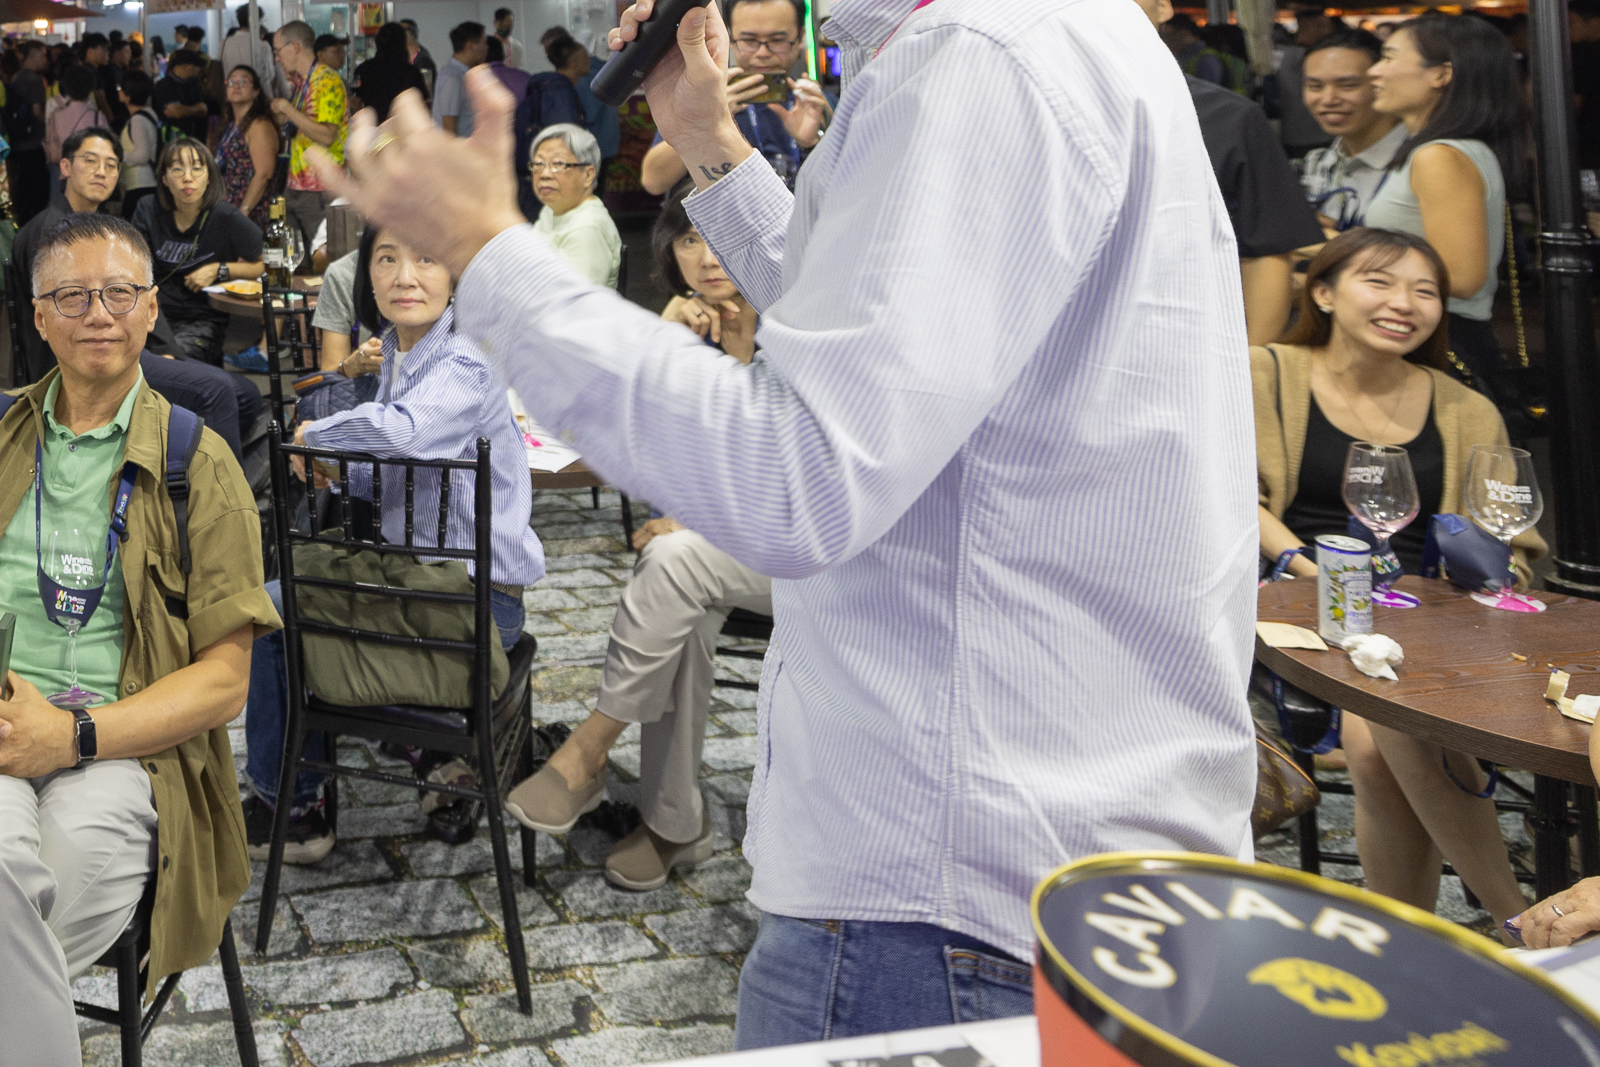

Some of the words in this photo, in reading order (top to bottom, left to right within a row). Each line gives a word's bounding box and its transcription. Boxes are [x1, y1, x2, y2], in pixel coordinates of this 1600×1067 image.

[1484, 479, 1519, 493] Wine
[61, 554, 84, 565] Wine
[56, 589, 78, 603] Wine
[1085, 882, 1390, 989] CAVIAR
